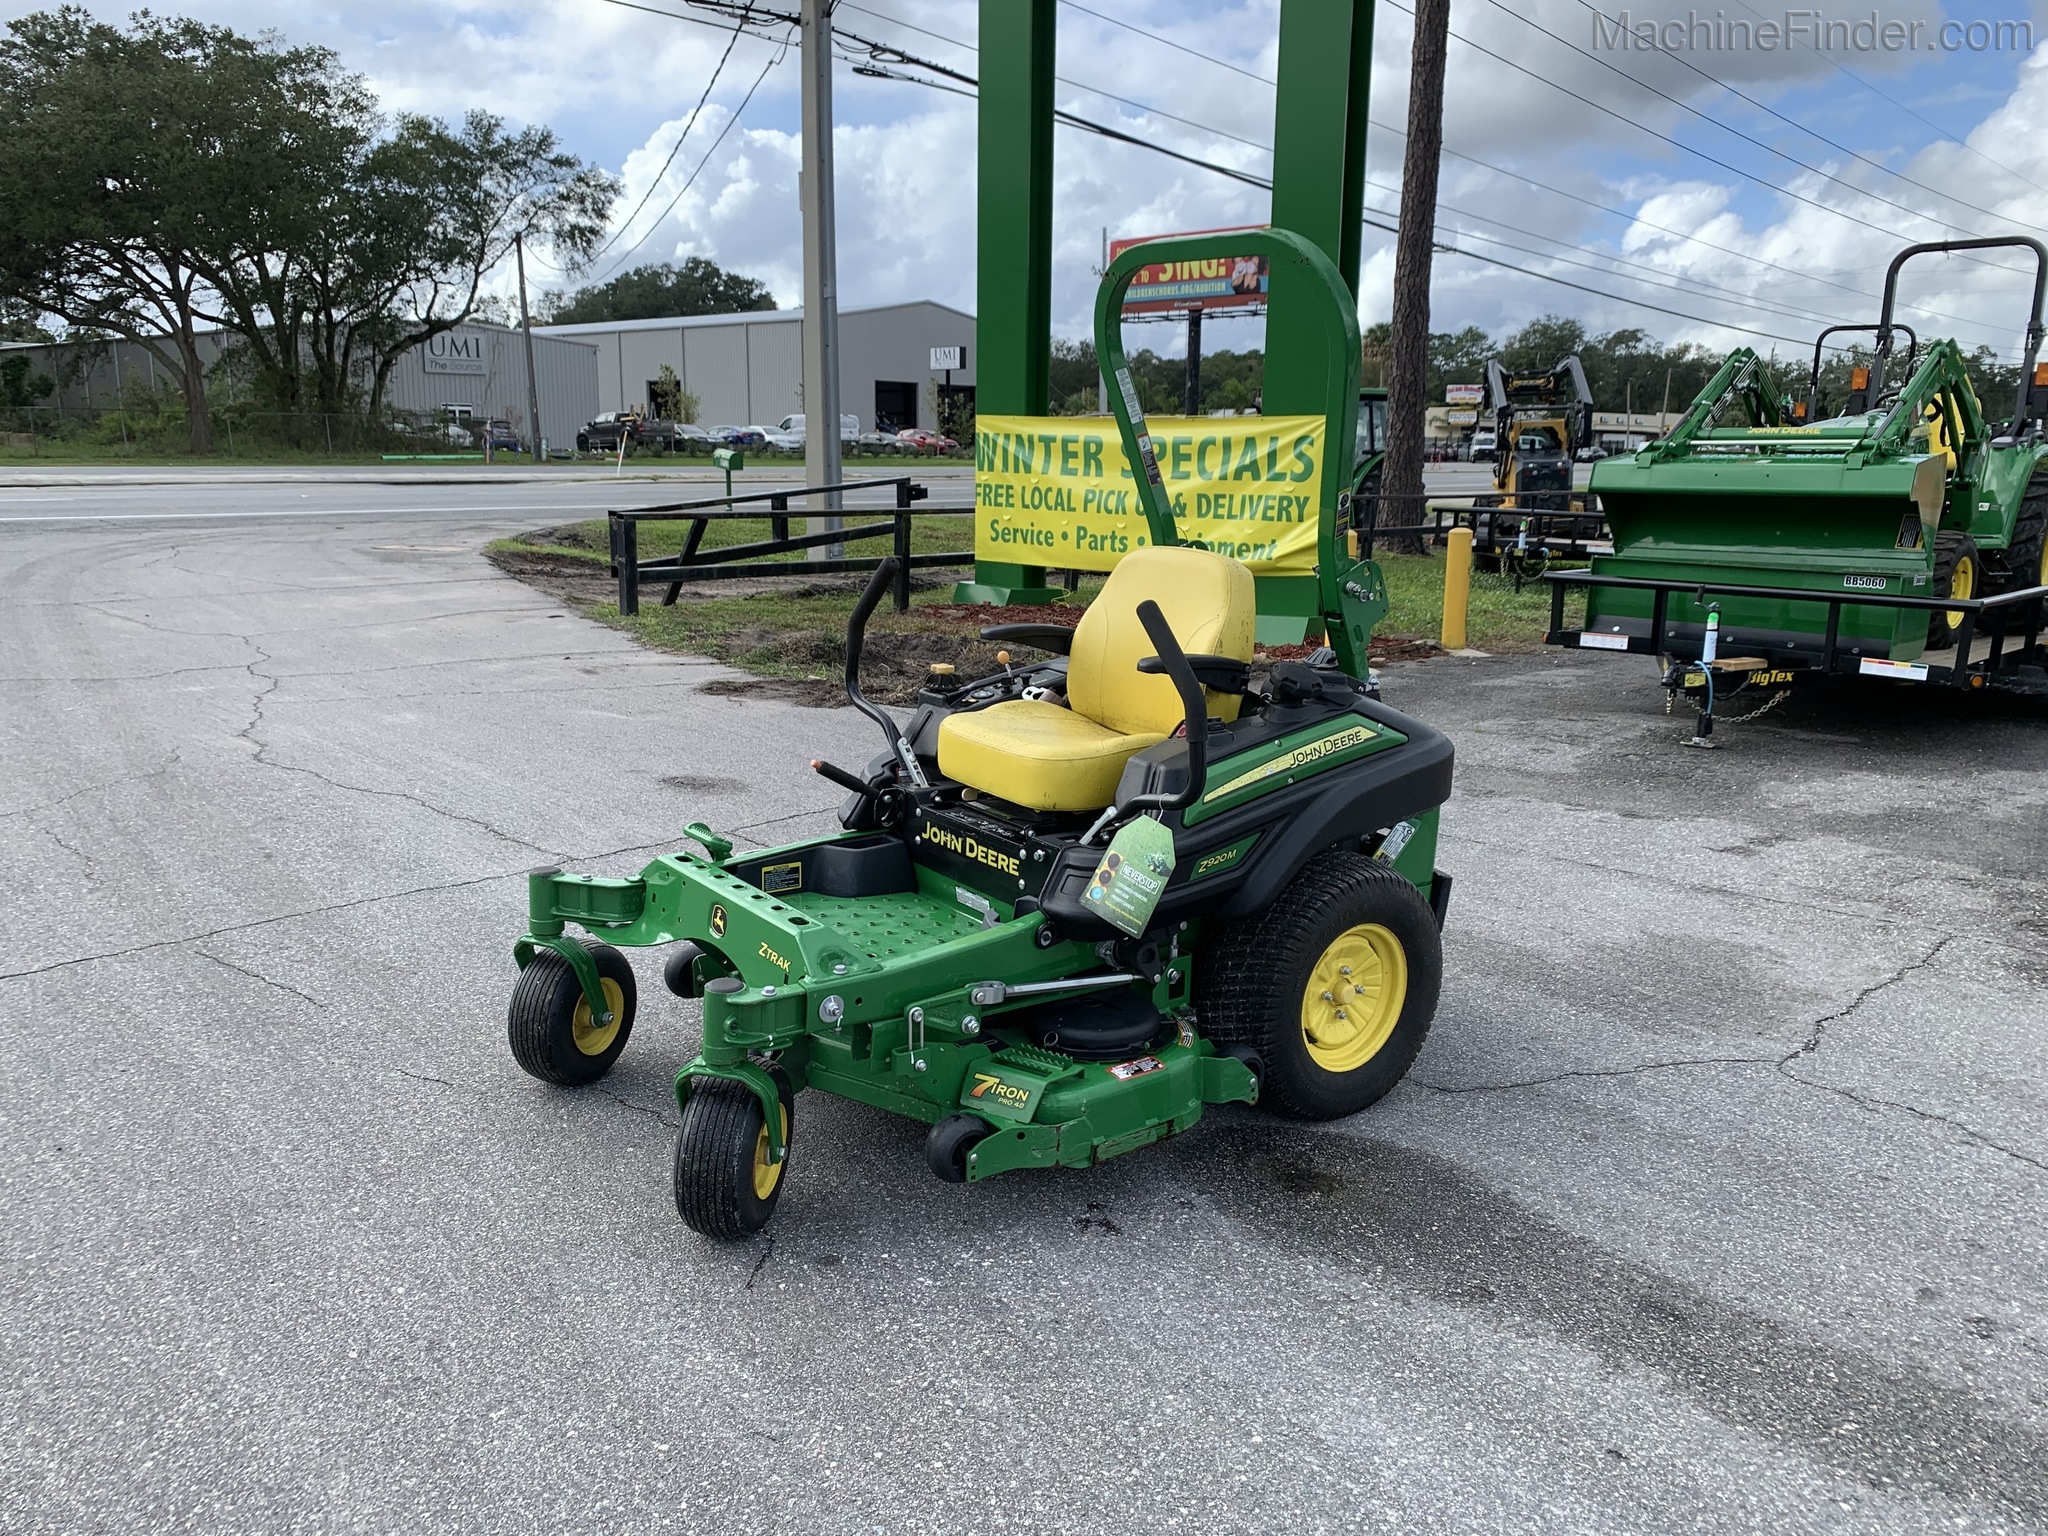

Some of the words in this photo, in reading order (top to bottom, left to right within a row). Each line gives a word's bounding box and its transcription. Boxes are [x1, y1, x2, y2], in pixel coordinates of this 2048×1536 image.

[429, 336, 481, 358] UMI
[934, 348, 956, 360] UMI
[429, 360, 447, 370] The
[1780, 427, 1821, 435] DEERE
[976, 432, 1104, 477] WINTER
[976, 483, 1015, 508] FREE
[1021, 485, 1077, 512] LOCAL
[1083, 489, 1129, 516] PICK
[1172, 492, 1187, 518] &
[1197, 491, 1311, 523] DELIVERY
[990, 519, 1054, 547] Service
[1076, 525, 1129, 553] Parts
[1845, 575, 1886, 589] BB5060
[1290, 744, 1323, 768] JOHN
[1323, 731, 1363, 754] DEERE
[922, 821, 962, 853] JOHN
[965, 837, 1019, 876] DEERE
[1198, 849, 1238, 873] Z920M
[1122, 864, 1159, 890] NEVERSTOP
[758, 942, 792, 972] ZTRAK
[998, 1097, 1013, 1106] PRO
